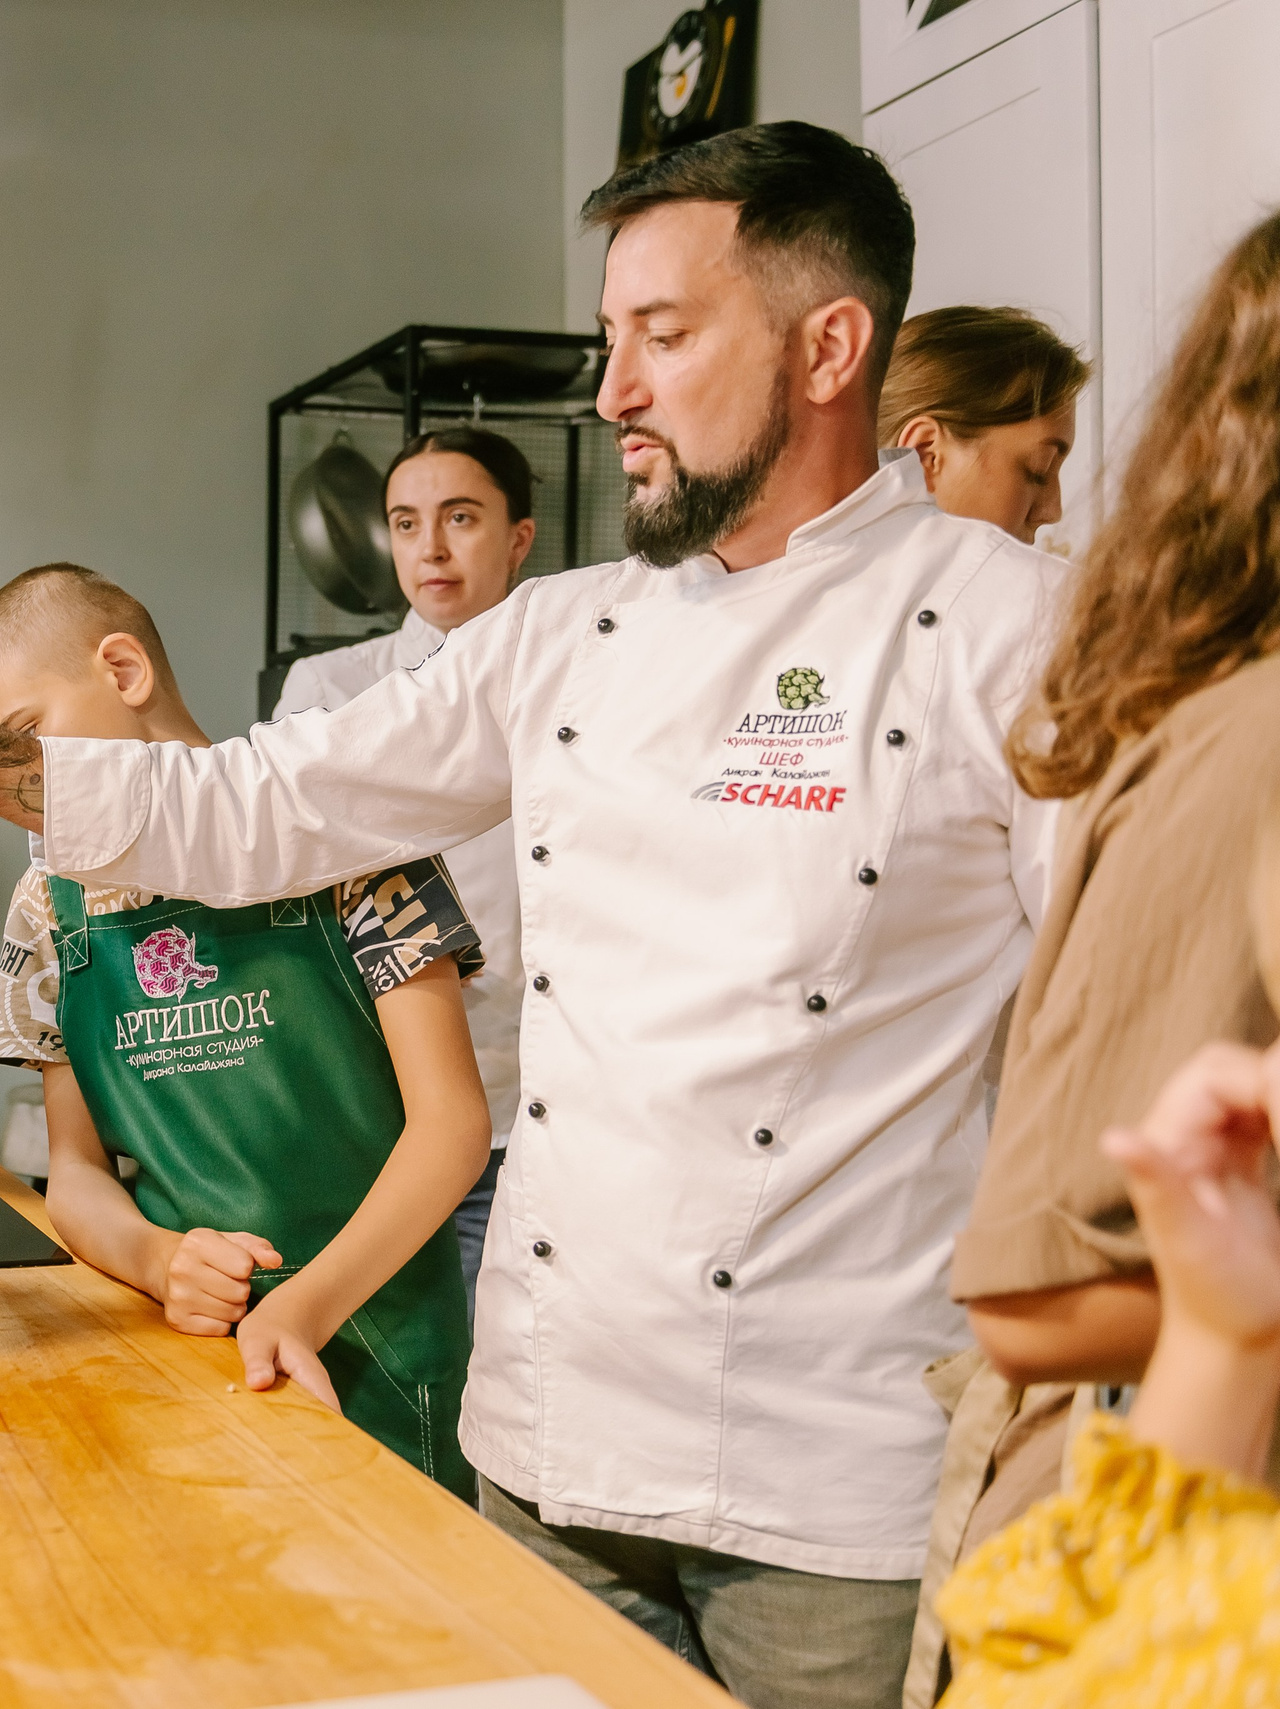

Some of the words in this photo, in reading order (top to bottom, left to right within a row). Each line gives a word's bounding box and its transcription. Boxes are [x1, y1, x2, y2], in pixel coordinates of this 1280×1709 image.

[735, 709, 848, 735] АРТИШОК
[806, 734, 846, 748] студия
[758, 751, 805, 767] ШЕФ
[720, 782, 847, 813] SCHARF
[114, 989, 275, 1051] АРТИШОК
[206, 1035, 259, 1056] студия
[177, 1056, 245, 1074] Калайджяна
